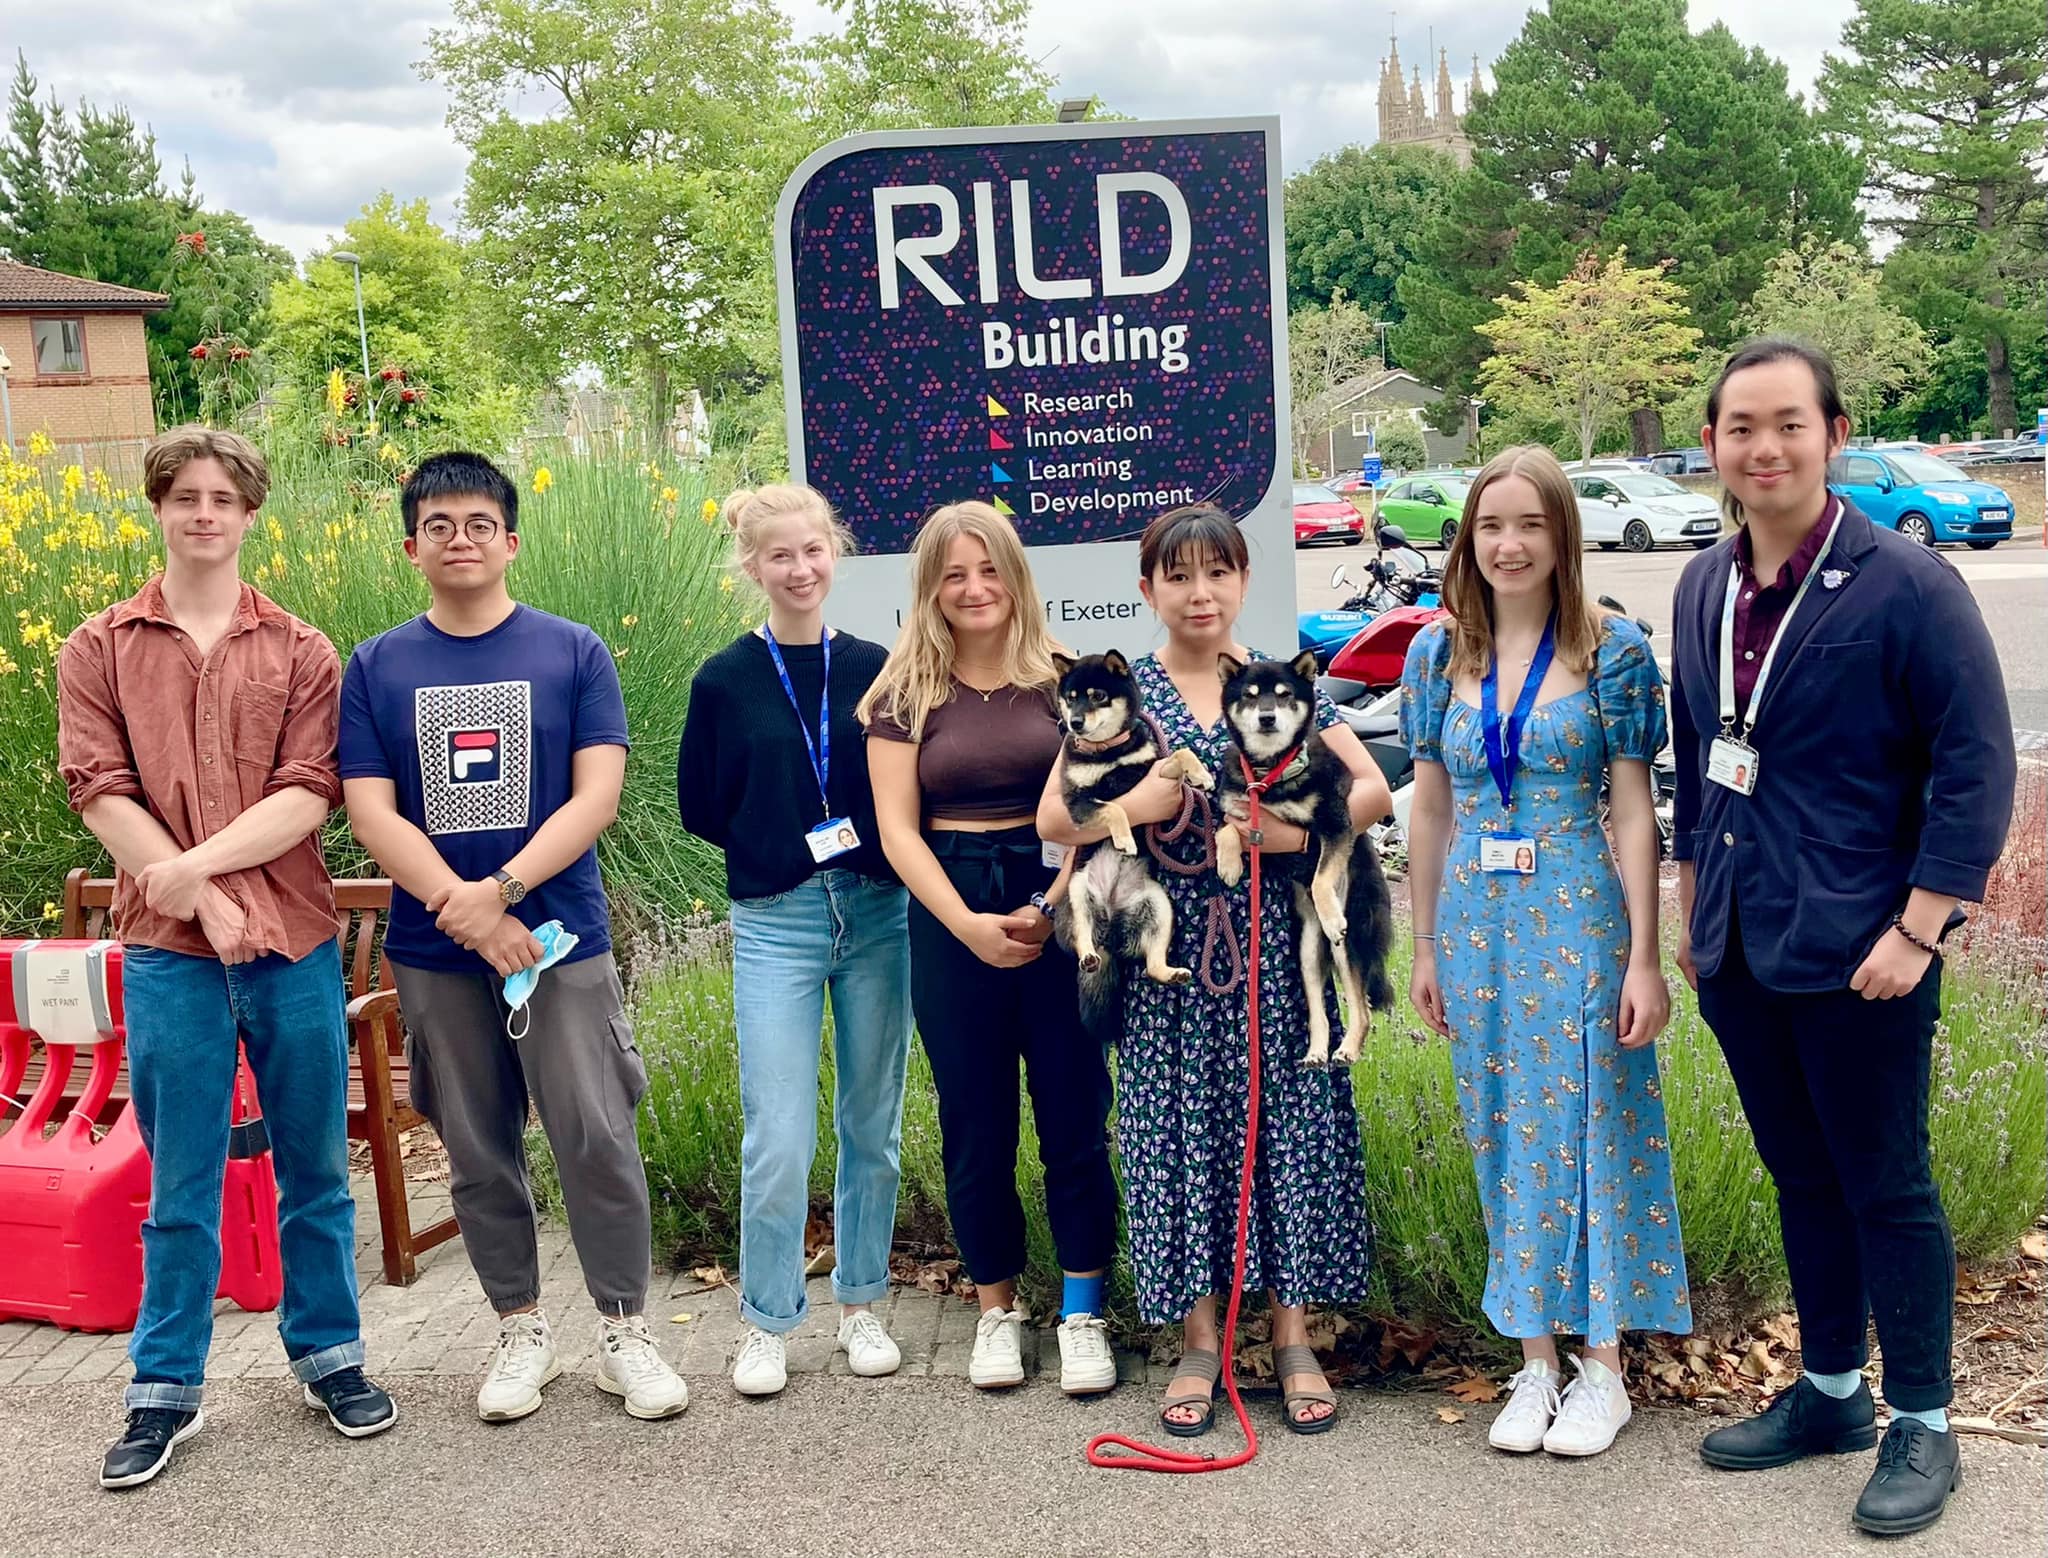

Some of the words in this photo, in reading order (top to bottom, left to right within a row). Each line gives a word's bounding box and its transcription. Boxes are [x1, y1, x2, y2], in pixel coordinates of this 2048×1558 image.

[872, 171, 1193, 310] RILD
[982, 315, 1190, 373] Building
[1024, 387, 1134, 415] Research
[1026, 423, 1153, 448] Innovation
[1028, 457, 1133, 482] Learning
[1030, 485, 1194, 516] Development
[1061, 599, 1142, 622] Exeter
[1320, 613, 1362, 621] SUZUKI
[41, 998, 57, 1007] WET
[59, 998, 79, 1007] PAINT
